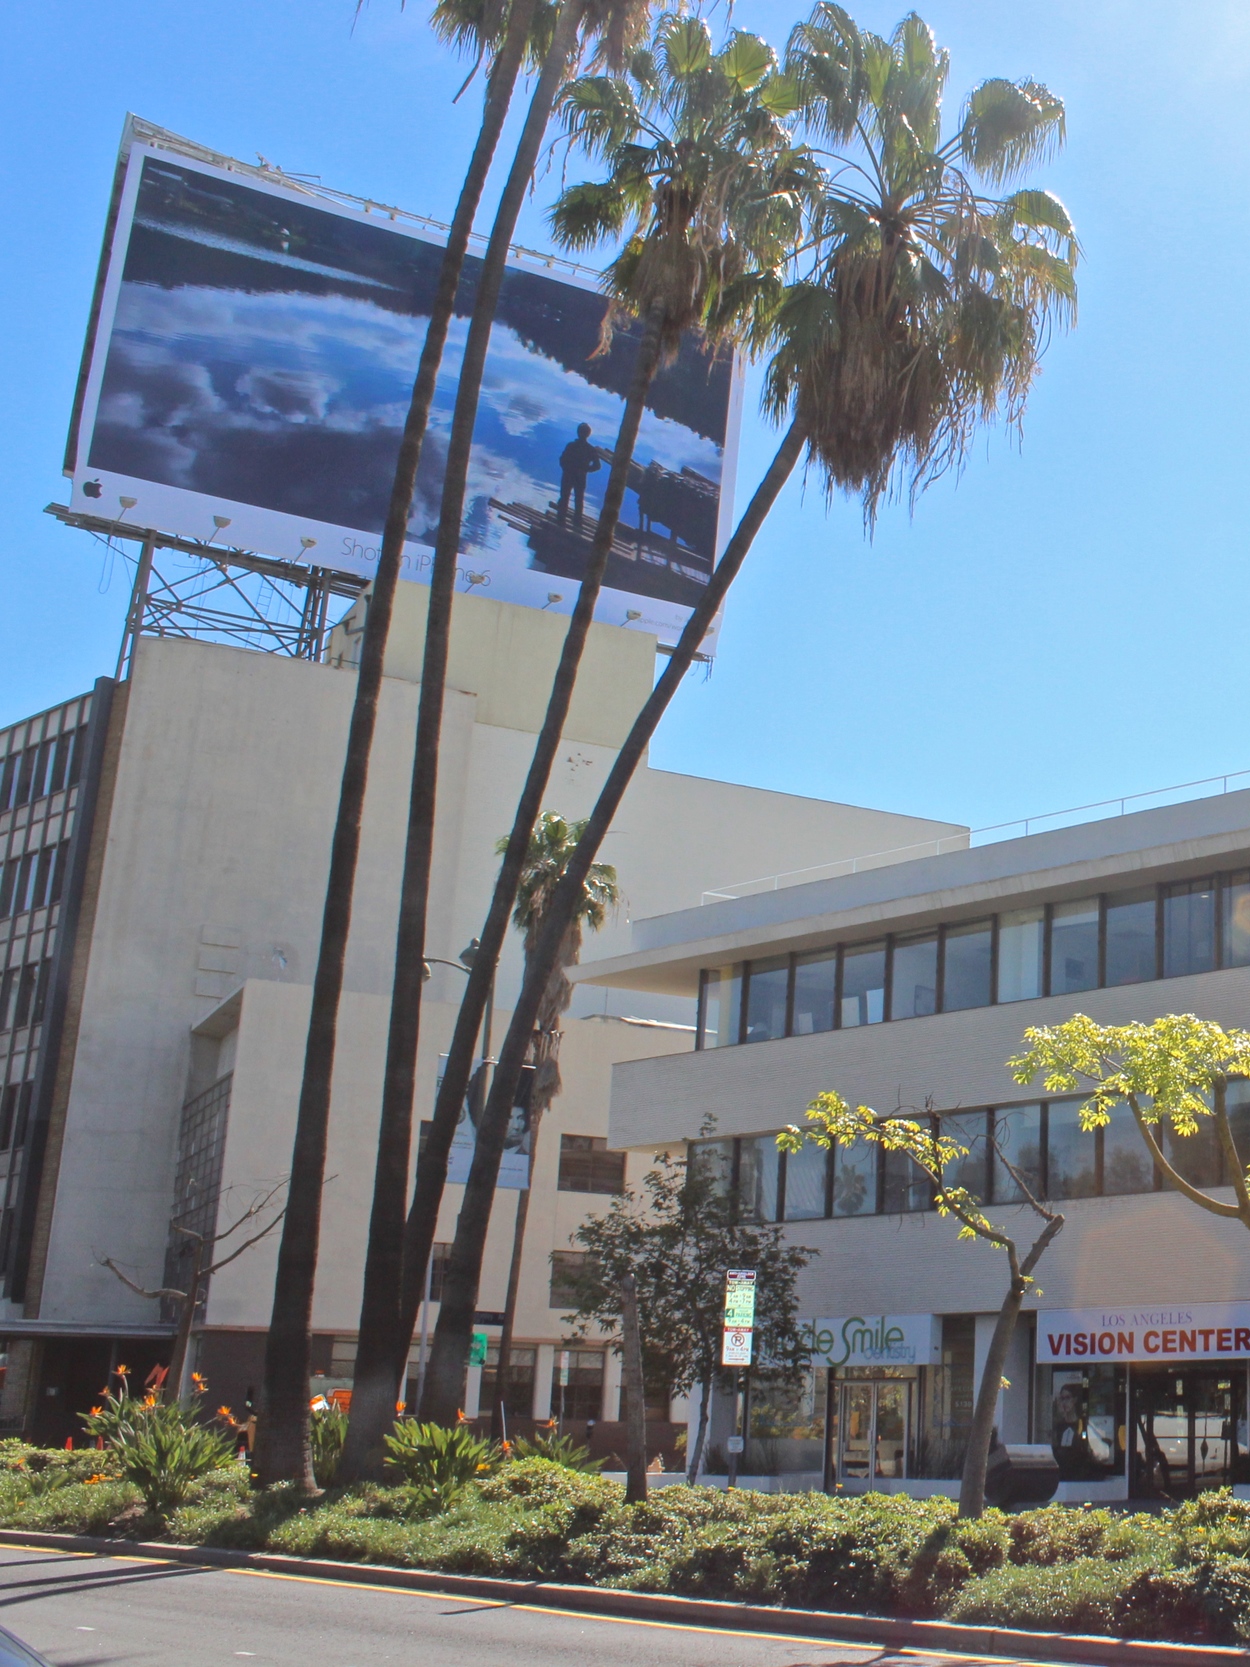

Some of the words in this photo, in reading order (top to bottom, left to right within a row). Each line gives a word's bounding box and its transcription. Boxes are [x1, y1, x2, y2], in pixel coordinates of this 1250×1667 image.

[341, 537, 381, 562] Shot
[1102, 1314, 1126, 1327] LOS
[1131, 1311, 1193, 1326] ANGELES
[826, 1316, 904, 1366] Smile
[864, 1343, 916, 1364] dentistry
[1047, 1331, 1134, 1356] VISION
